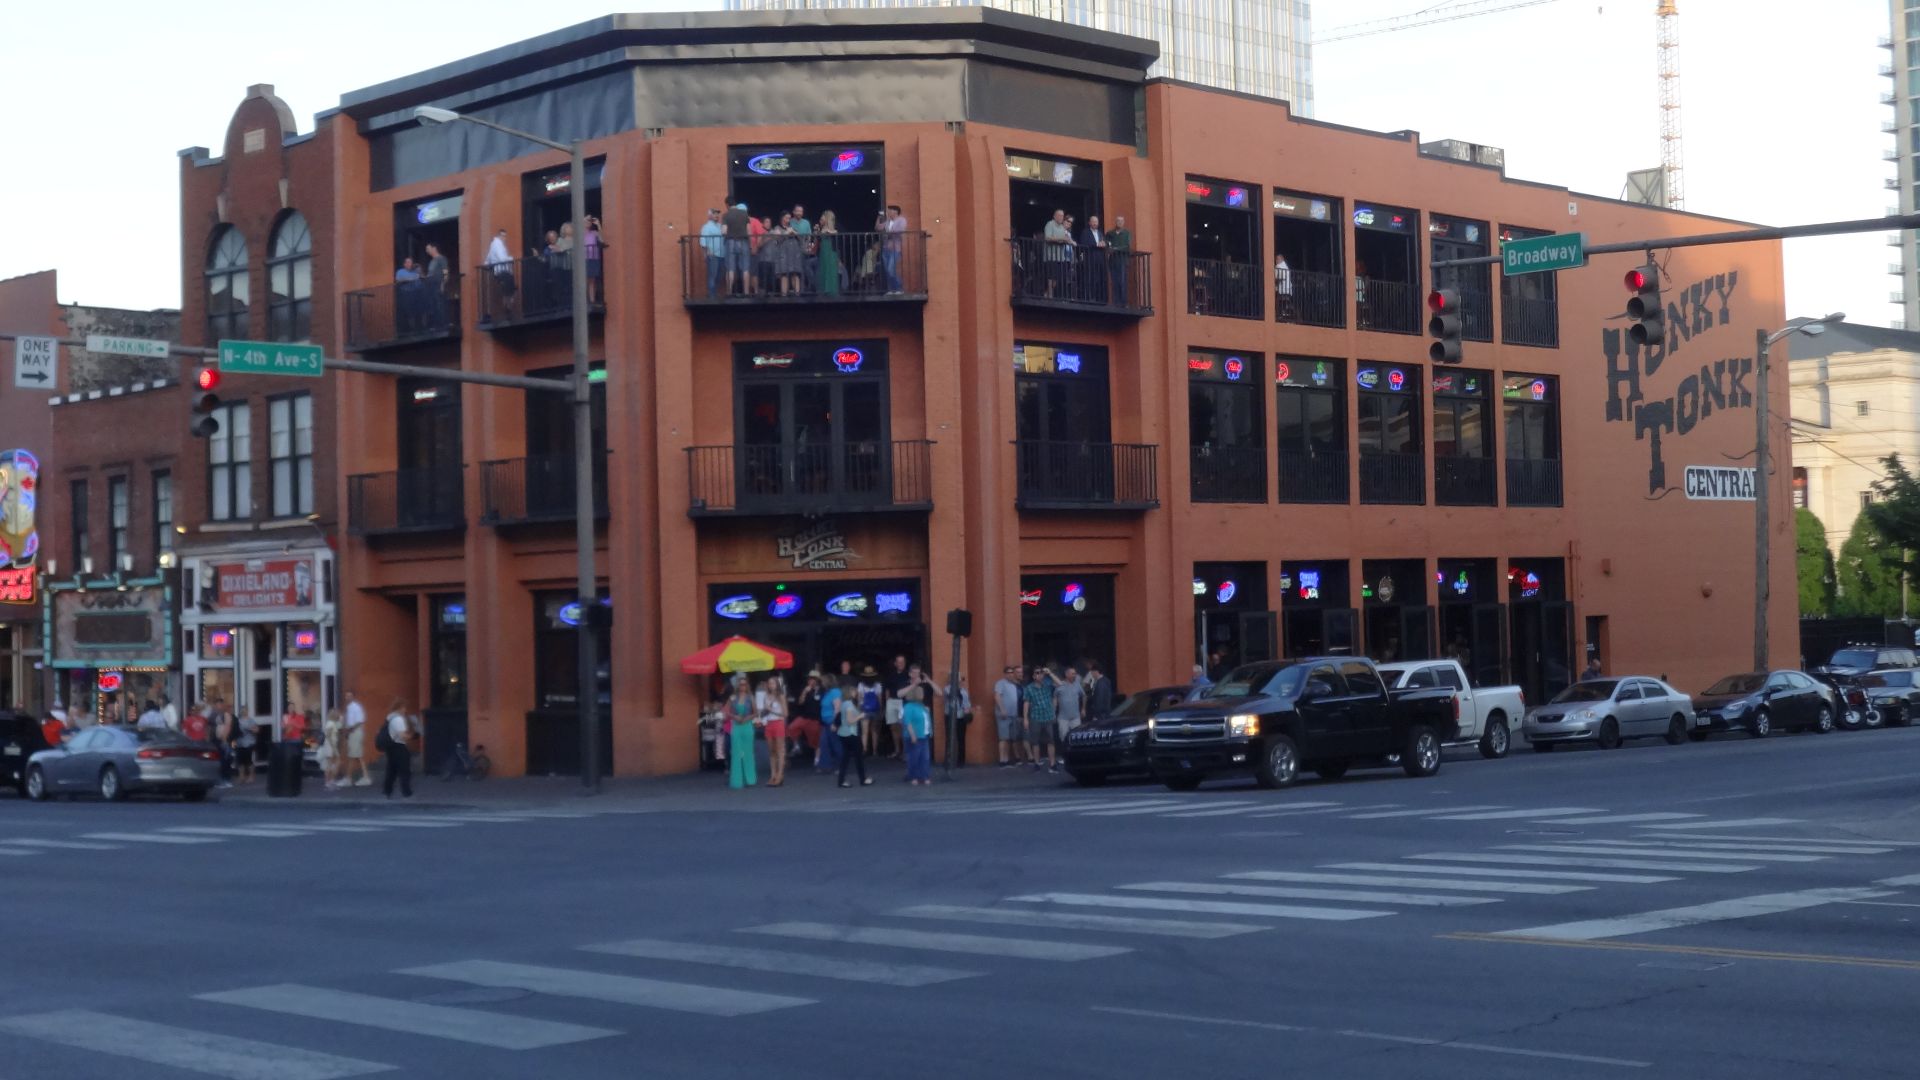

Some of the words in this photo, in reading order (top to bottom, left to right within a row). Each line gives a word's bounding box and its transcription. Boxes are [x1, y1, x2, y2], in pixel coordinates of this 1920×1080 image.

[1508, 245, 1577, 266] Broadway
[23, 339, 50, 351] ONE
[103, 339, 153, 354] PARKING
[22, 353, 51, 367] WAY
[1634, 358, 1752, 495] TONK
[809, 560, 847, 569] CENTRAL
[221, 573, 289, 592] DIXIELAND
[1521, 588, 1539, 597] LIGHT
